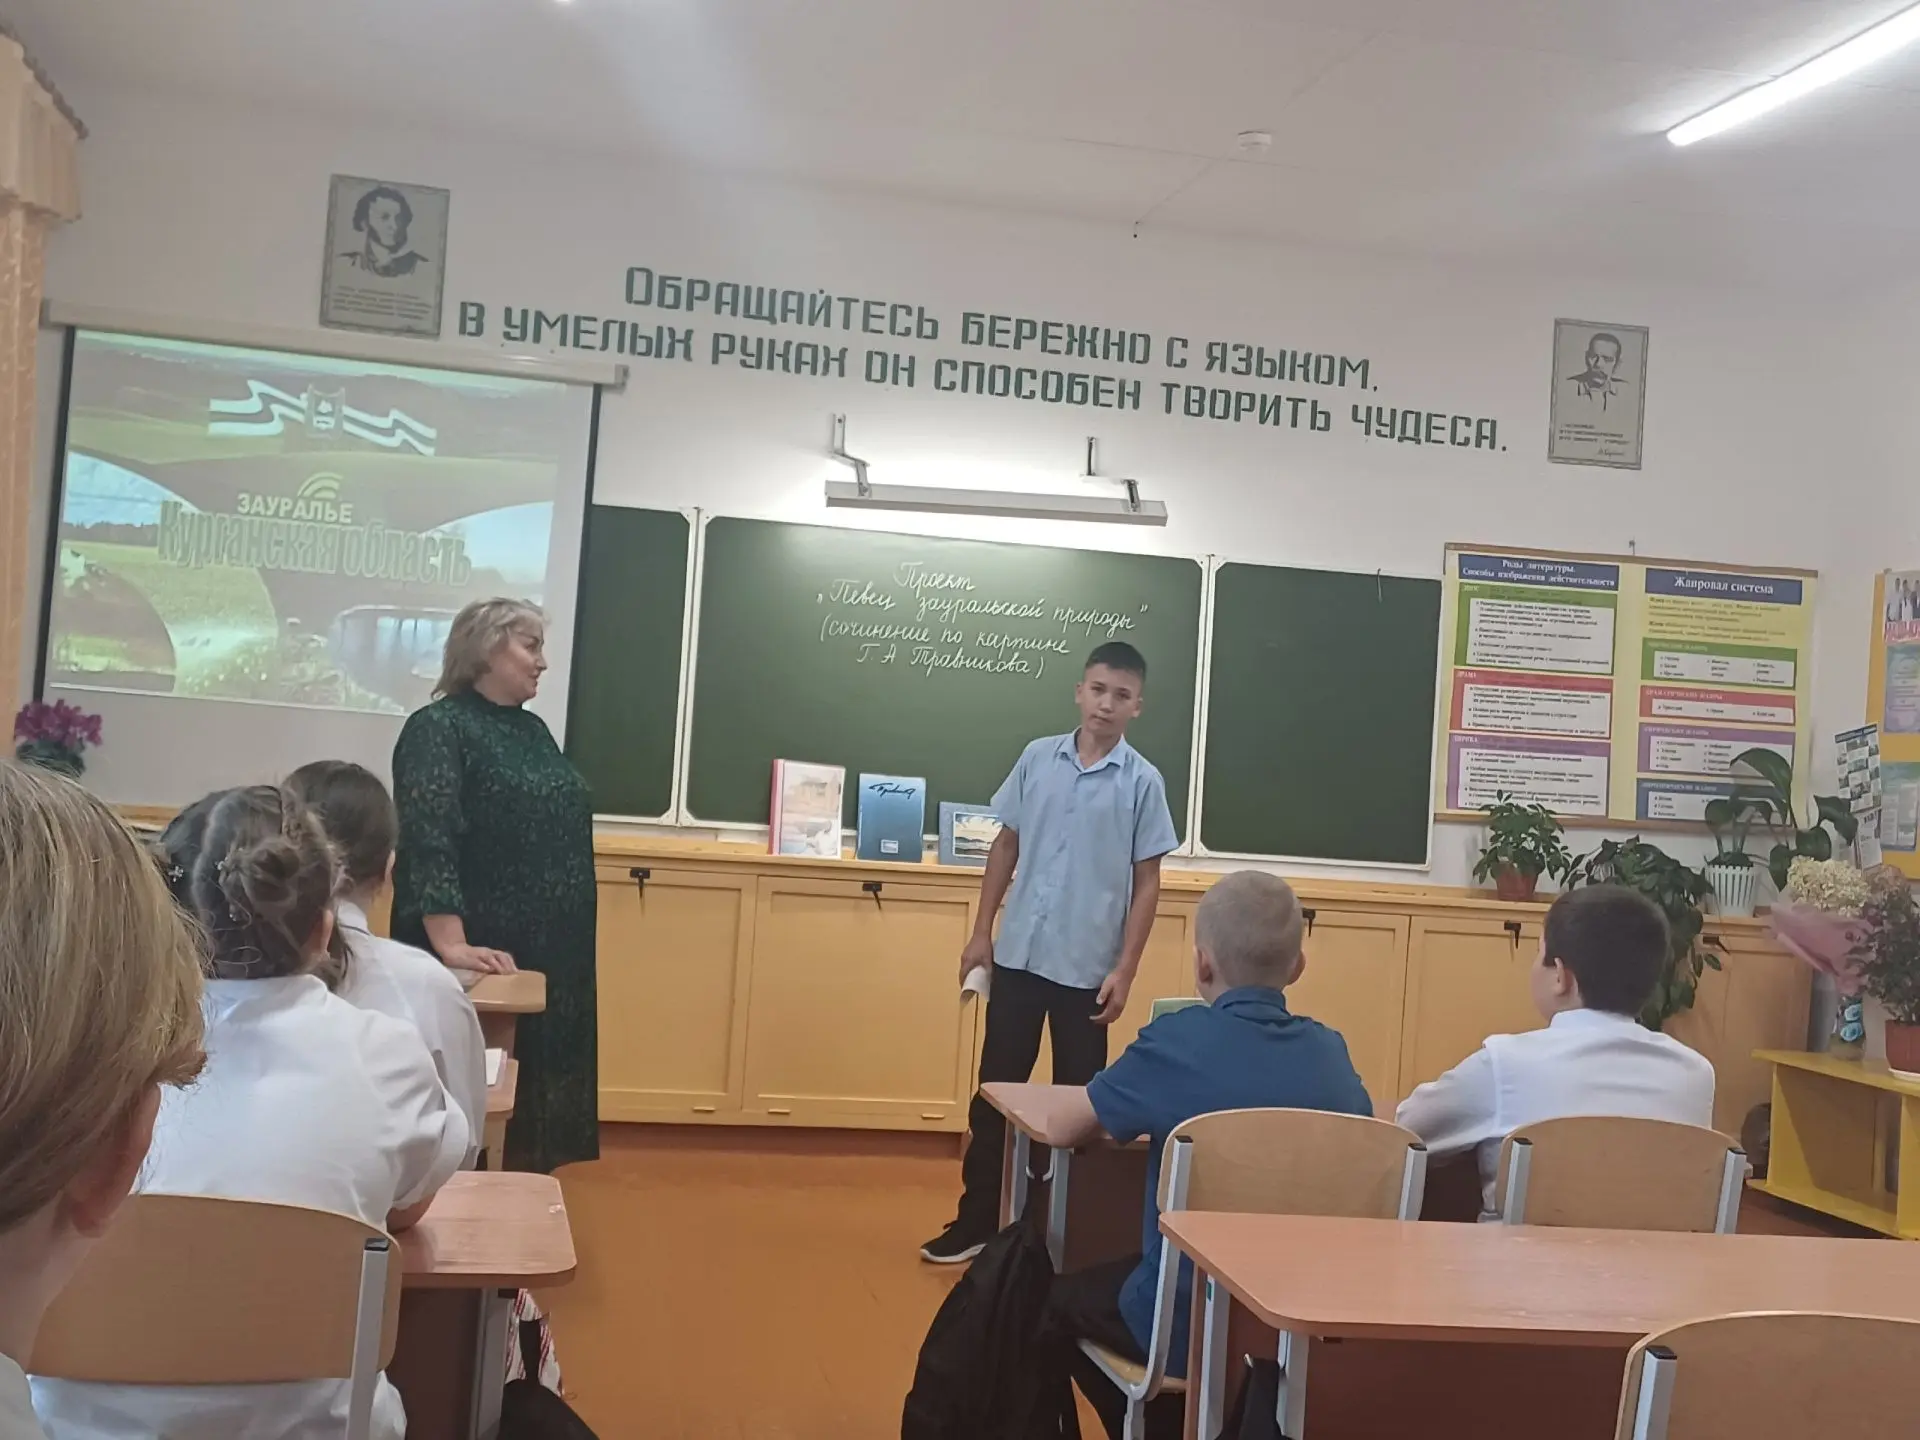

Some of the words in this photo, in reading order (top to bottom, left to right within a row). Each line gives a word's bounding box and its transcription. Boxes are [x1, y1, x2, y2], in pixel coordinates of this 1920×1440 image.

[961, 311, 1151, 365] БЕРЕЖНО
[1204, 341, 1379, 392] ЯЗЫКОМ.
[458, 301, 485, 337] В
[502, 306, 694, 362] УМЕЛЫХ
[711, 332, 848, 377] РУКАХ
[865, 350, 916, 388] ОН
[933, 357, 1142, 411] СПОСОБЕН
[1160, 381, 1331, 432] ТВОРИТЬ
[1350, 403, 1508, 452] ЧУДЕСА.
[236, 491, 354, 523] ЗАУРАЛЬЕ
[158, 500, 337, 575] Курганская
[341, 518, 472, 587] область
[893, 561, 976, 598] Проект
[1462, 567, 1495, 578] Способы
[1497, 569, 1546, 582] изображения
[1548, 574, 1615, 587] действительности
[1502, 559, 1523, 569] Роды
[1674, 575, 1728, 592] Жанровая
[1730, 582, 1774, 595] система
[915, 594, 1046, 624] зауральской
[940, 629, 964, 645] по
[976, 631, 1071, 661] картине
